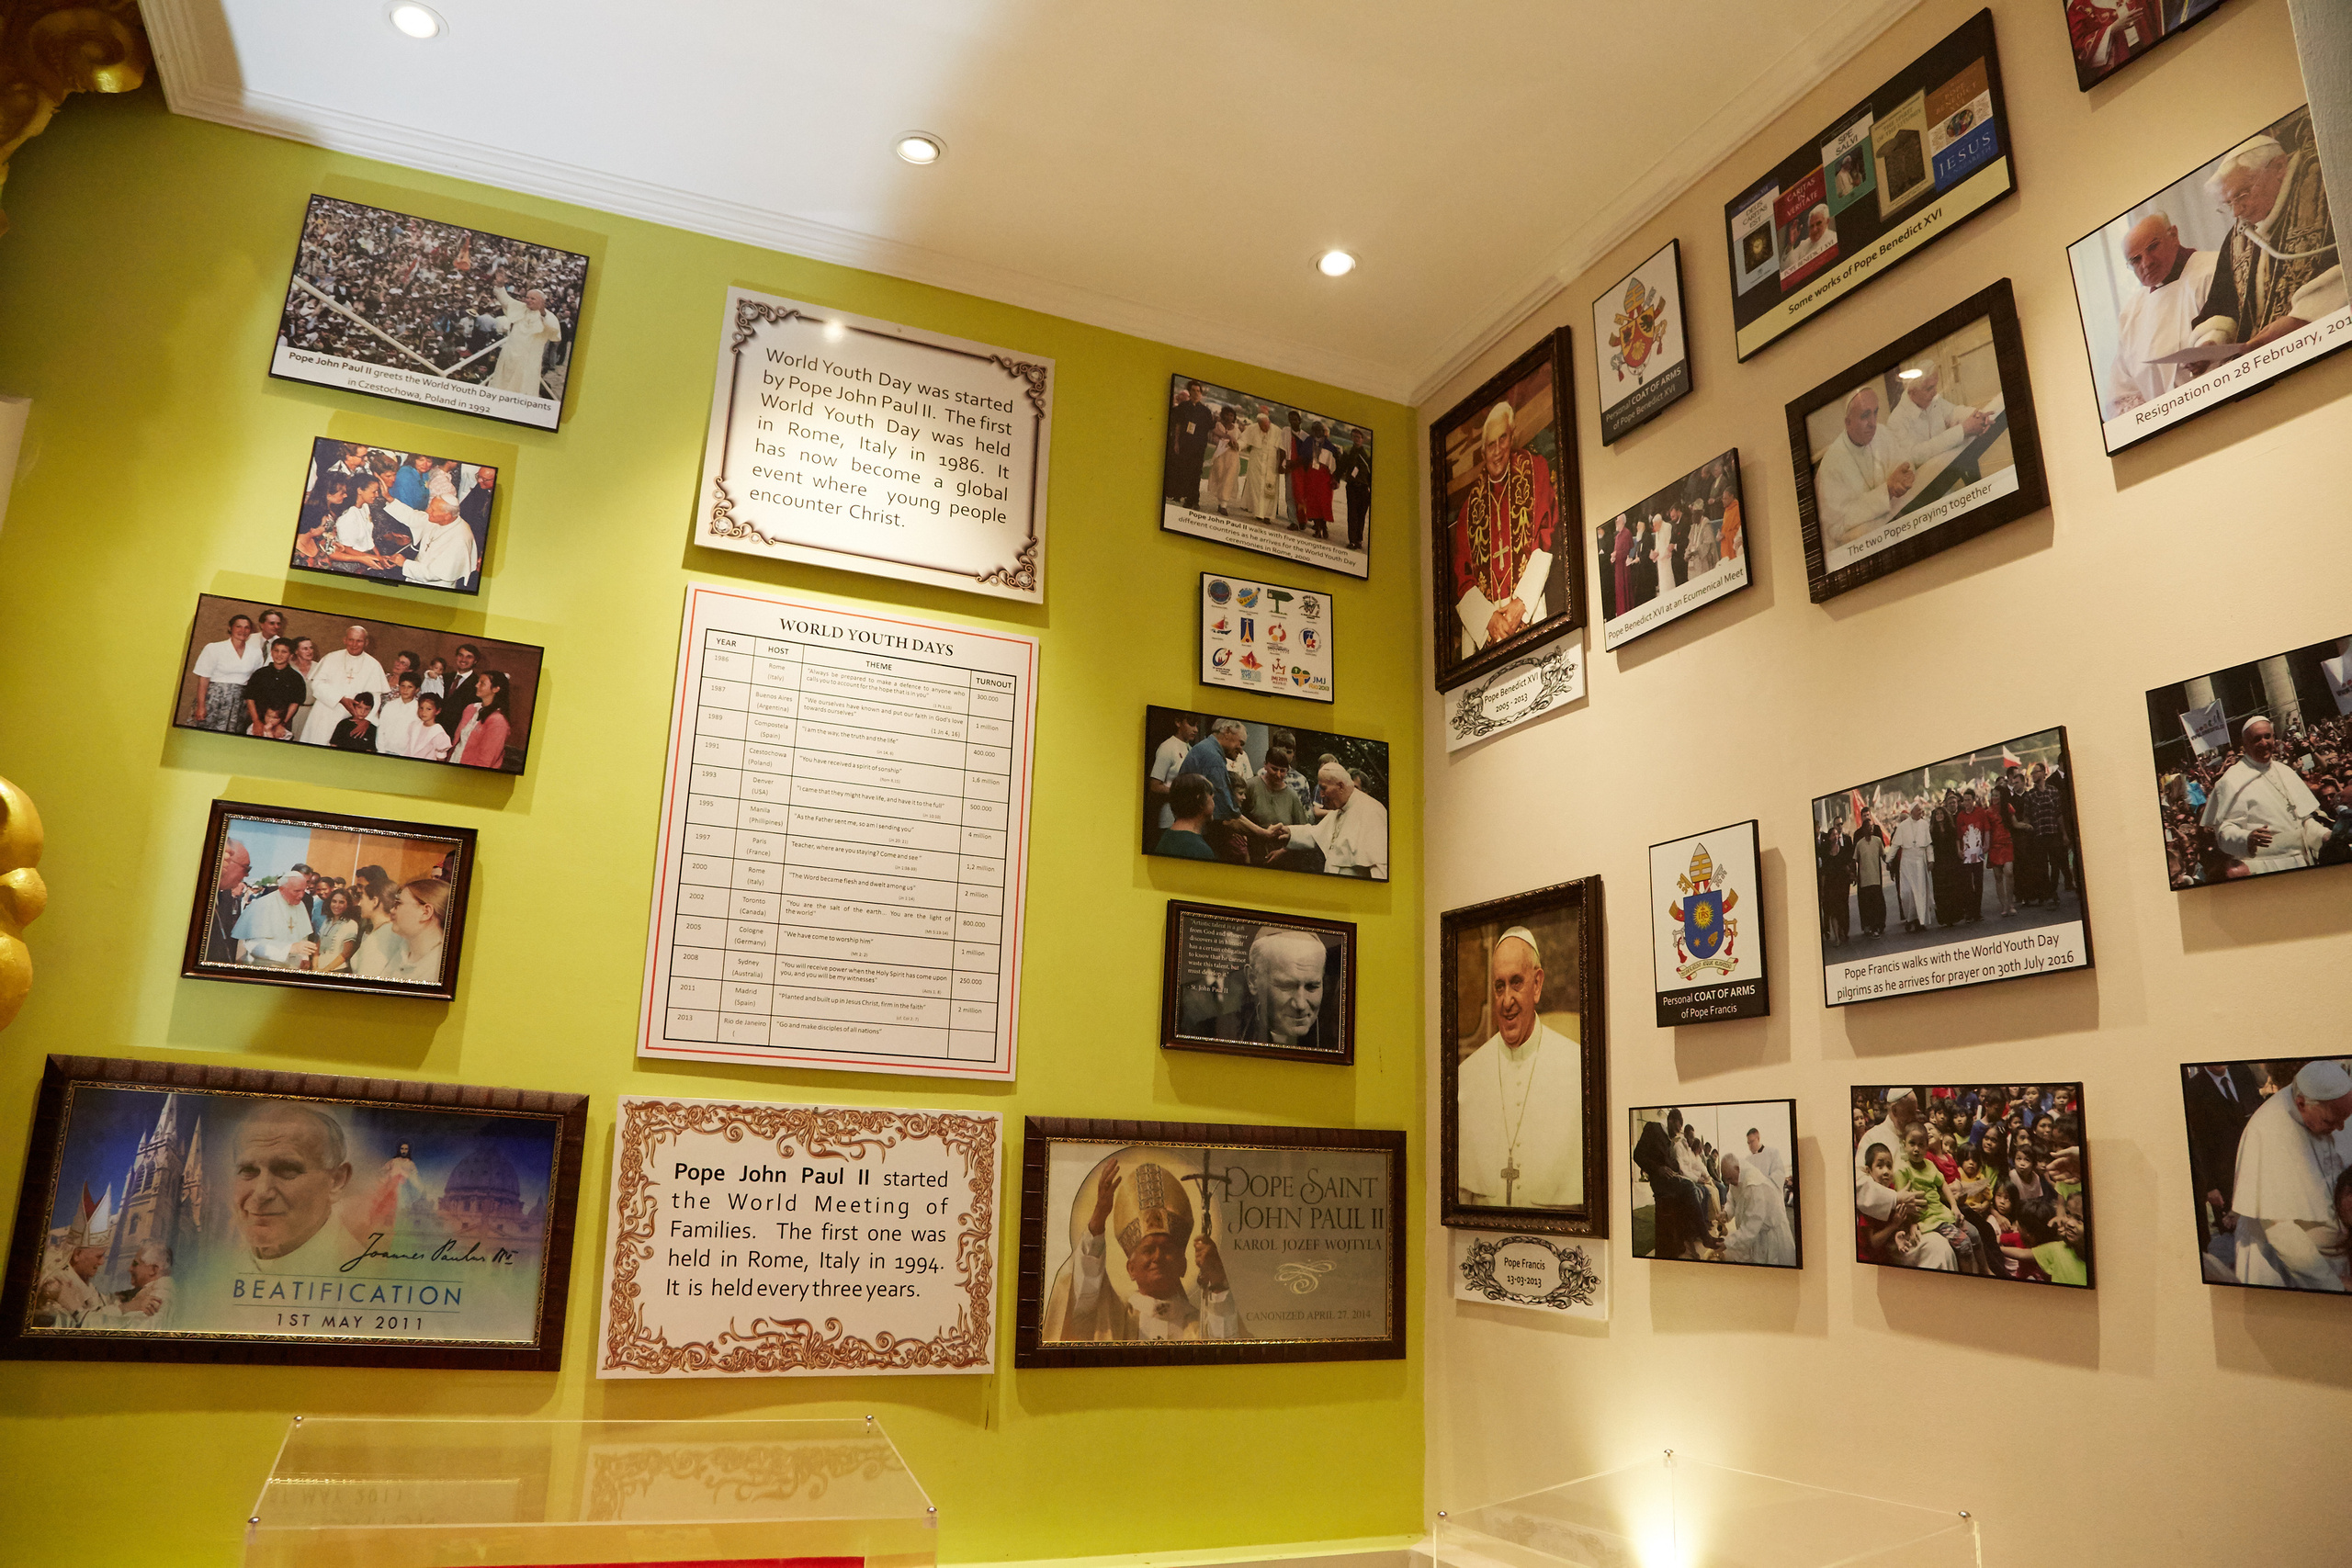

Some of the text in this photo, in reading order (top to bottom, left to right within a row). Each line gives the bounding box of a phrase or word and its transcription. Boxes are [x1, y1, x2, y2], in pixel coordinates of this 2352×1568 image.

[1939, 132, 1991, 178] JESUS
[1788, 208, 1941, 314] Some works of Pope Benedict XVI
[288, 352, 551, 411] Pope John Paul II greets the World Youth Day participants
[766, 347, 1012, 413] World Youth Day was started
[2135, 316, 2352, 424] Resignation on 28 February, 201
[358, 380, 423, 401] Czestochowa,
[424, 393, 458, 407] Poland
[458, 400, 467, 408] in
[469, 403, 491, 413] 1992
[763, 369, 1012, 435] by Pope John Paul II. The first
[761, 392, 1010, 457] World Youth Day was held
[758, 415, 1010, 479] in Rome, Italy in 1986. It
[1847, 483, 1992, 556] The two Popes praying together
[1608, 627, 1624, 640] Pope
[1624, 613, 1653, 632] Benedict
[1653, 606, 1665, 619] XVI
[1665, 603, 1672, 612] at
[1674, 599, 1682, 608] an
[1683, 576, 1723, 603] Ecumenical
[717, 637, 737, 647] YEAR
[768, 646, 790, 655] HOST
[780, 618, 953, 656] WORLD YOUTH DAYS
[865, 661, 893, 671] THEME
[976, 678, 1012, 689] TURNOUT
[1485, 672, 1538, 704] Pope Benedict XVI
[1496, 702, 1510, 713] 2005
[1514, 694, 1528, 705] 2013
[737, 958, 759, 966] Sydney
[1844, 935, 2059, 981] Pope Francis walks with the World Youth Day
[731, 970, 763, 978] (Australia)
[1838, 952, 2074, 1001] pilgrims as he arrives for prayer on 30th July 2016
[1663, 985, 1755, 1006] Personal COAT OF ARMS
[1681, 1003, 1737, 1019] of Pope Francis
[674, 1163, 947, 1188] Pope John Paul II started
[672, 1191, 949, 1219] the World Meeting of
[1227, 1201, 1384, 1235] JOHN PAUL II
[671, 1220, 945, 1242] Families. The first one was
[669, 1248, 944, 1274] held in Rome, Italy in 1994.
[1504, 1258, 1545, 1270] Pope Francis
[233, 1279, 461, 1305] BEATIFICATION
[667, 1279, 920, 1302] It is held every three years.
[1507, 1275, 1542, 1288] 13-03-2013
[277, 1314, 423, 1330] 1ST MAY 2011
